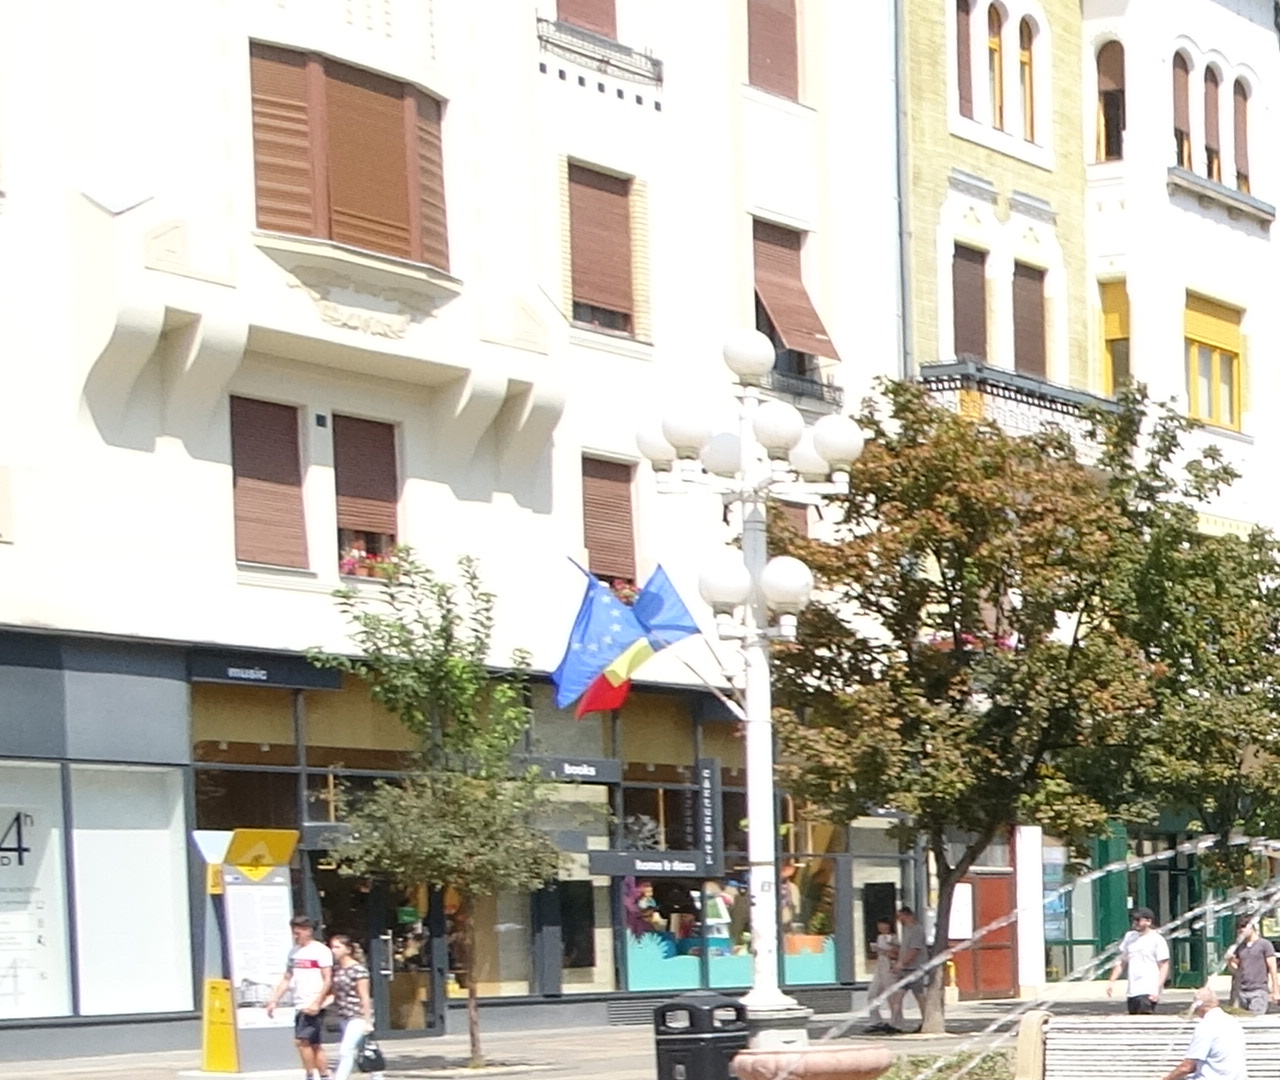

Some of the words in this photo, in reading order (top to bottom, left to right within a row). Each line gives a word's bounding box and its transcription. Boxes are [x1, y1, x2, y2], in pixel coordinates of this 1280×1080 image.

[227, 667, 268, 680] music
[563, 763, 597, 776] books
[634, 859, 663, 871] home
